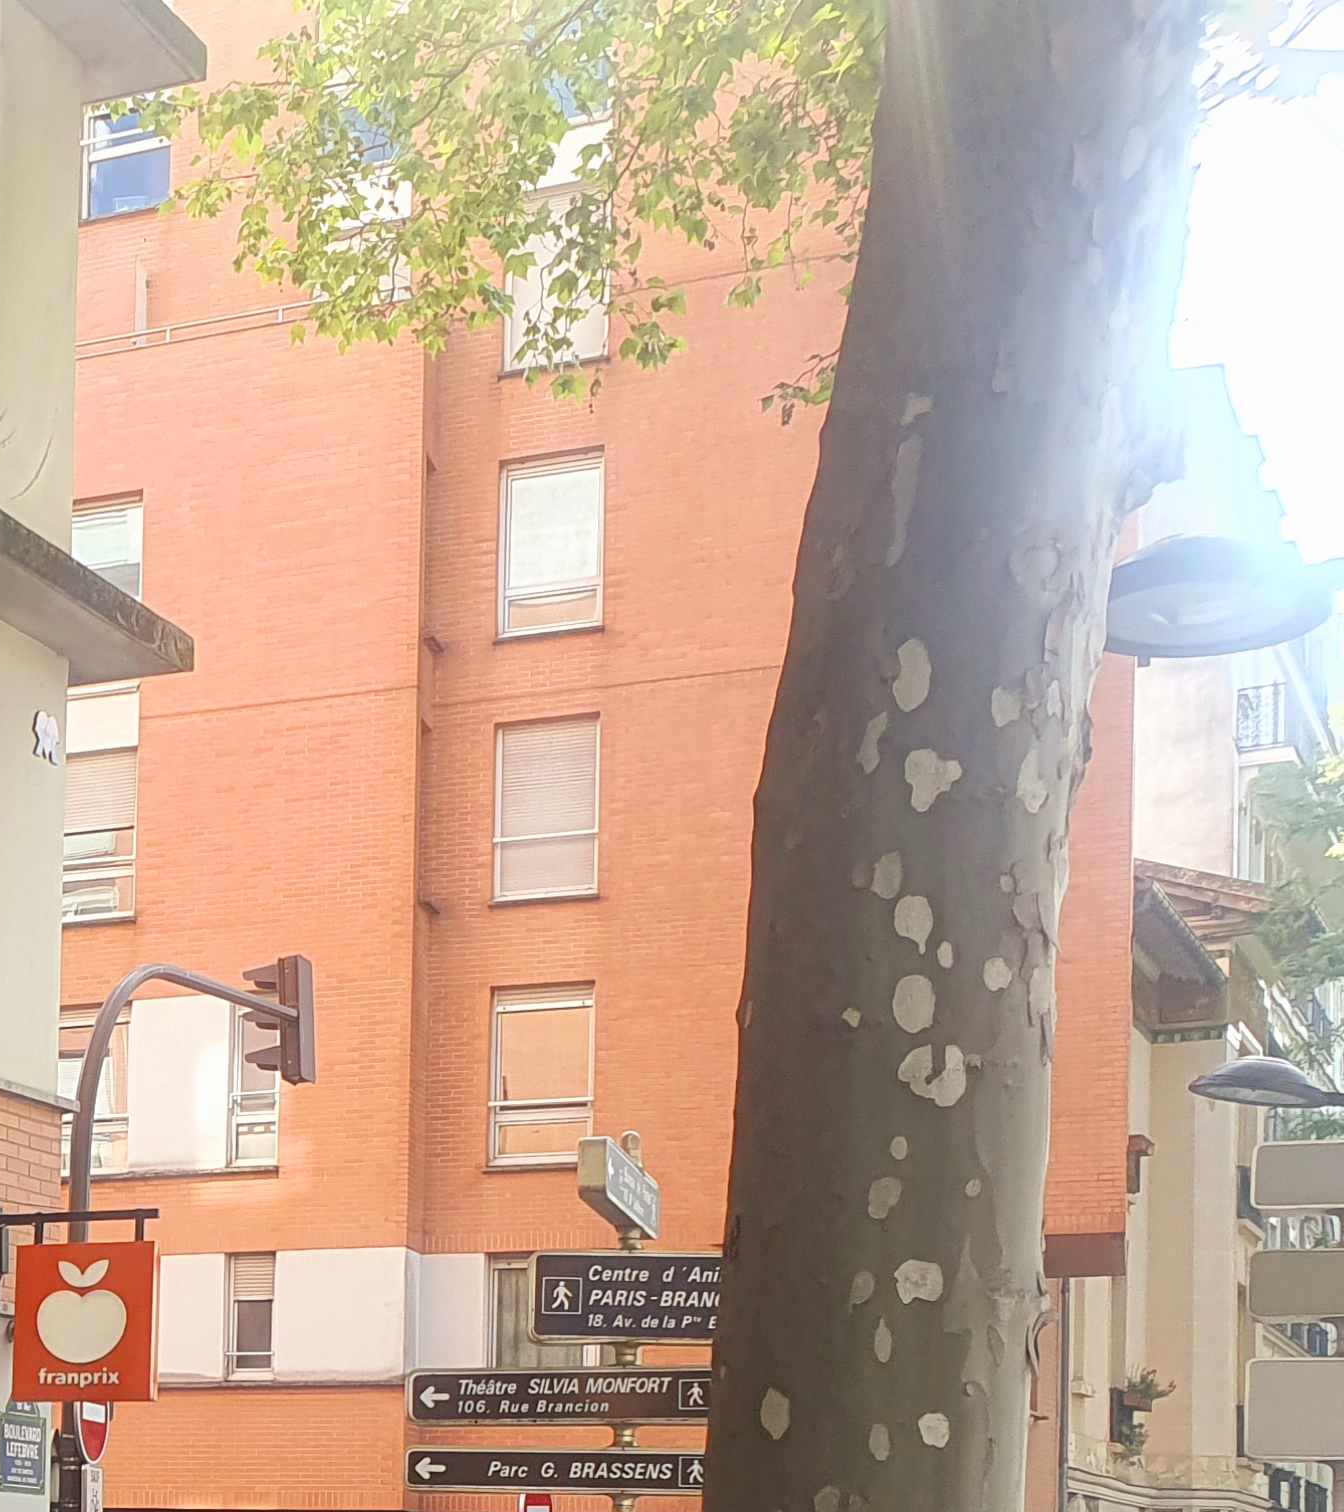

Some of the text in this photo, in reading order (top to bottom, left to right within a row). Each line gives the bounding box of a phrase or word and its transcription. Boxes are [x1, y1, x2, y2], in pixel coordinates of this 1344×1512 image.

[588, 1265, 649, 1282] Centre
[613, 1315, 636, 1328] Av.
[641, 1316, 659, 1329] de
[662, 1316, 675, 1329] la
[38, 1366, 120, 1388] franprix
[458, 1377, 672, 1396] Théâtre SILVIA MONFORT
[500, 1401, 530, 1413] Rue
[536, 1400, 609, 1413] Brancion
[4, 1424, 41, 1442] BOULEVARD
[6, 1441, 39, 1459] LEFEBVRE
[488, 1461, 673, 1480] Parc G. BRASSENS
